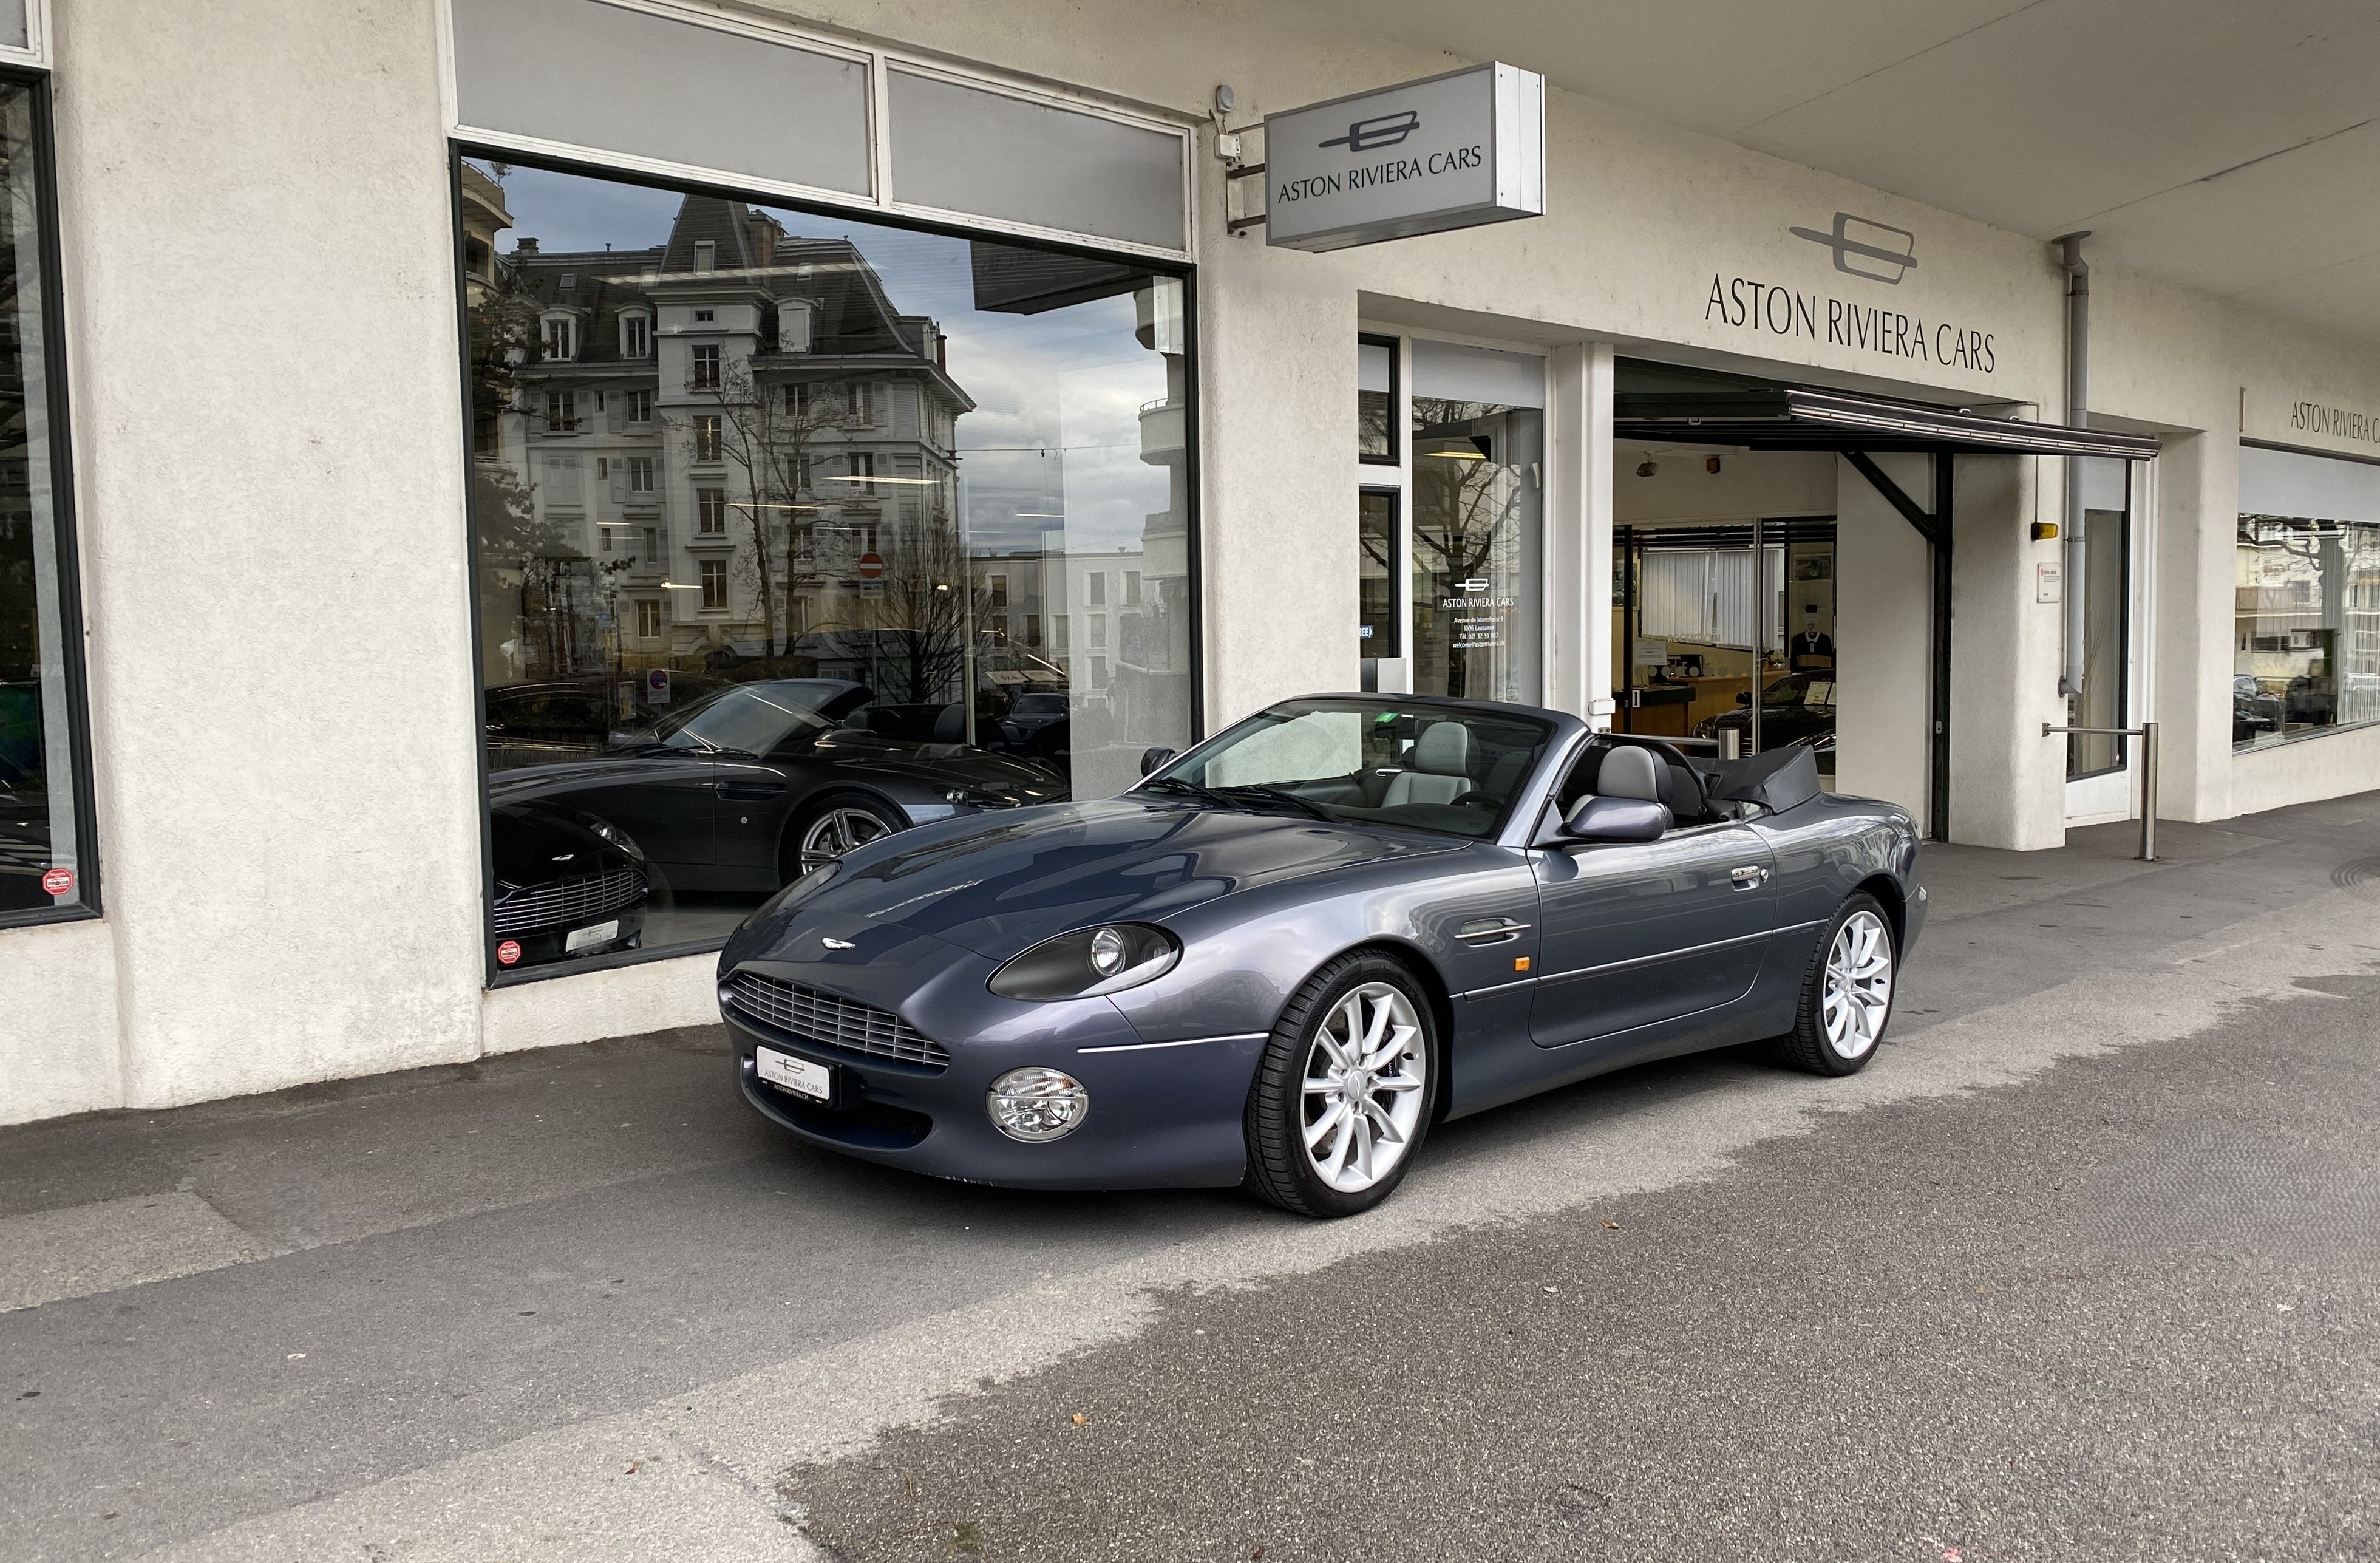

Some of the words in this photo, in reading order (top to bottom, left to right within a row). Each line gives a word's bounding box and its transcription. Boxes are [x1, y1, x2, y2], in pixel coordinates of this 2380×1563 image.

[1278, 173, 1341, 203] ASTON
[1348, 157, 1422, 190] RIVIERA
[1428, 145, 1481, 174] CARS
[1705, 273, 1816, 340] ASTON
[1829, 299, 1928, 361] RIVIERA
[1936, 324, 1995, 373] CARS
[2291, 401, 2330, 434] ASTON
[2333, 409, 2370, 441] RIVIERA
[1443, 598, 1467, 608] ASTON
[1469, 598, 1495, 607] RIVIERA
[1496, 597, 1514, 607] CARS
[764, 1070, 783, 1082] ASTON
[784, 1075, 806, 1088] RIVIERA
[807, 1083, 823, 1094] CARS
